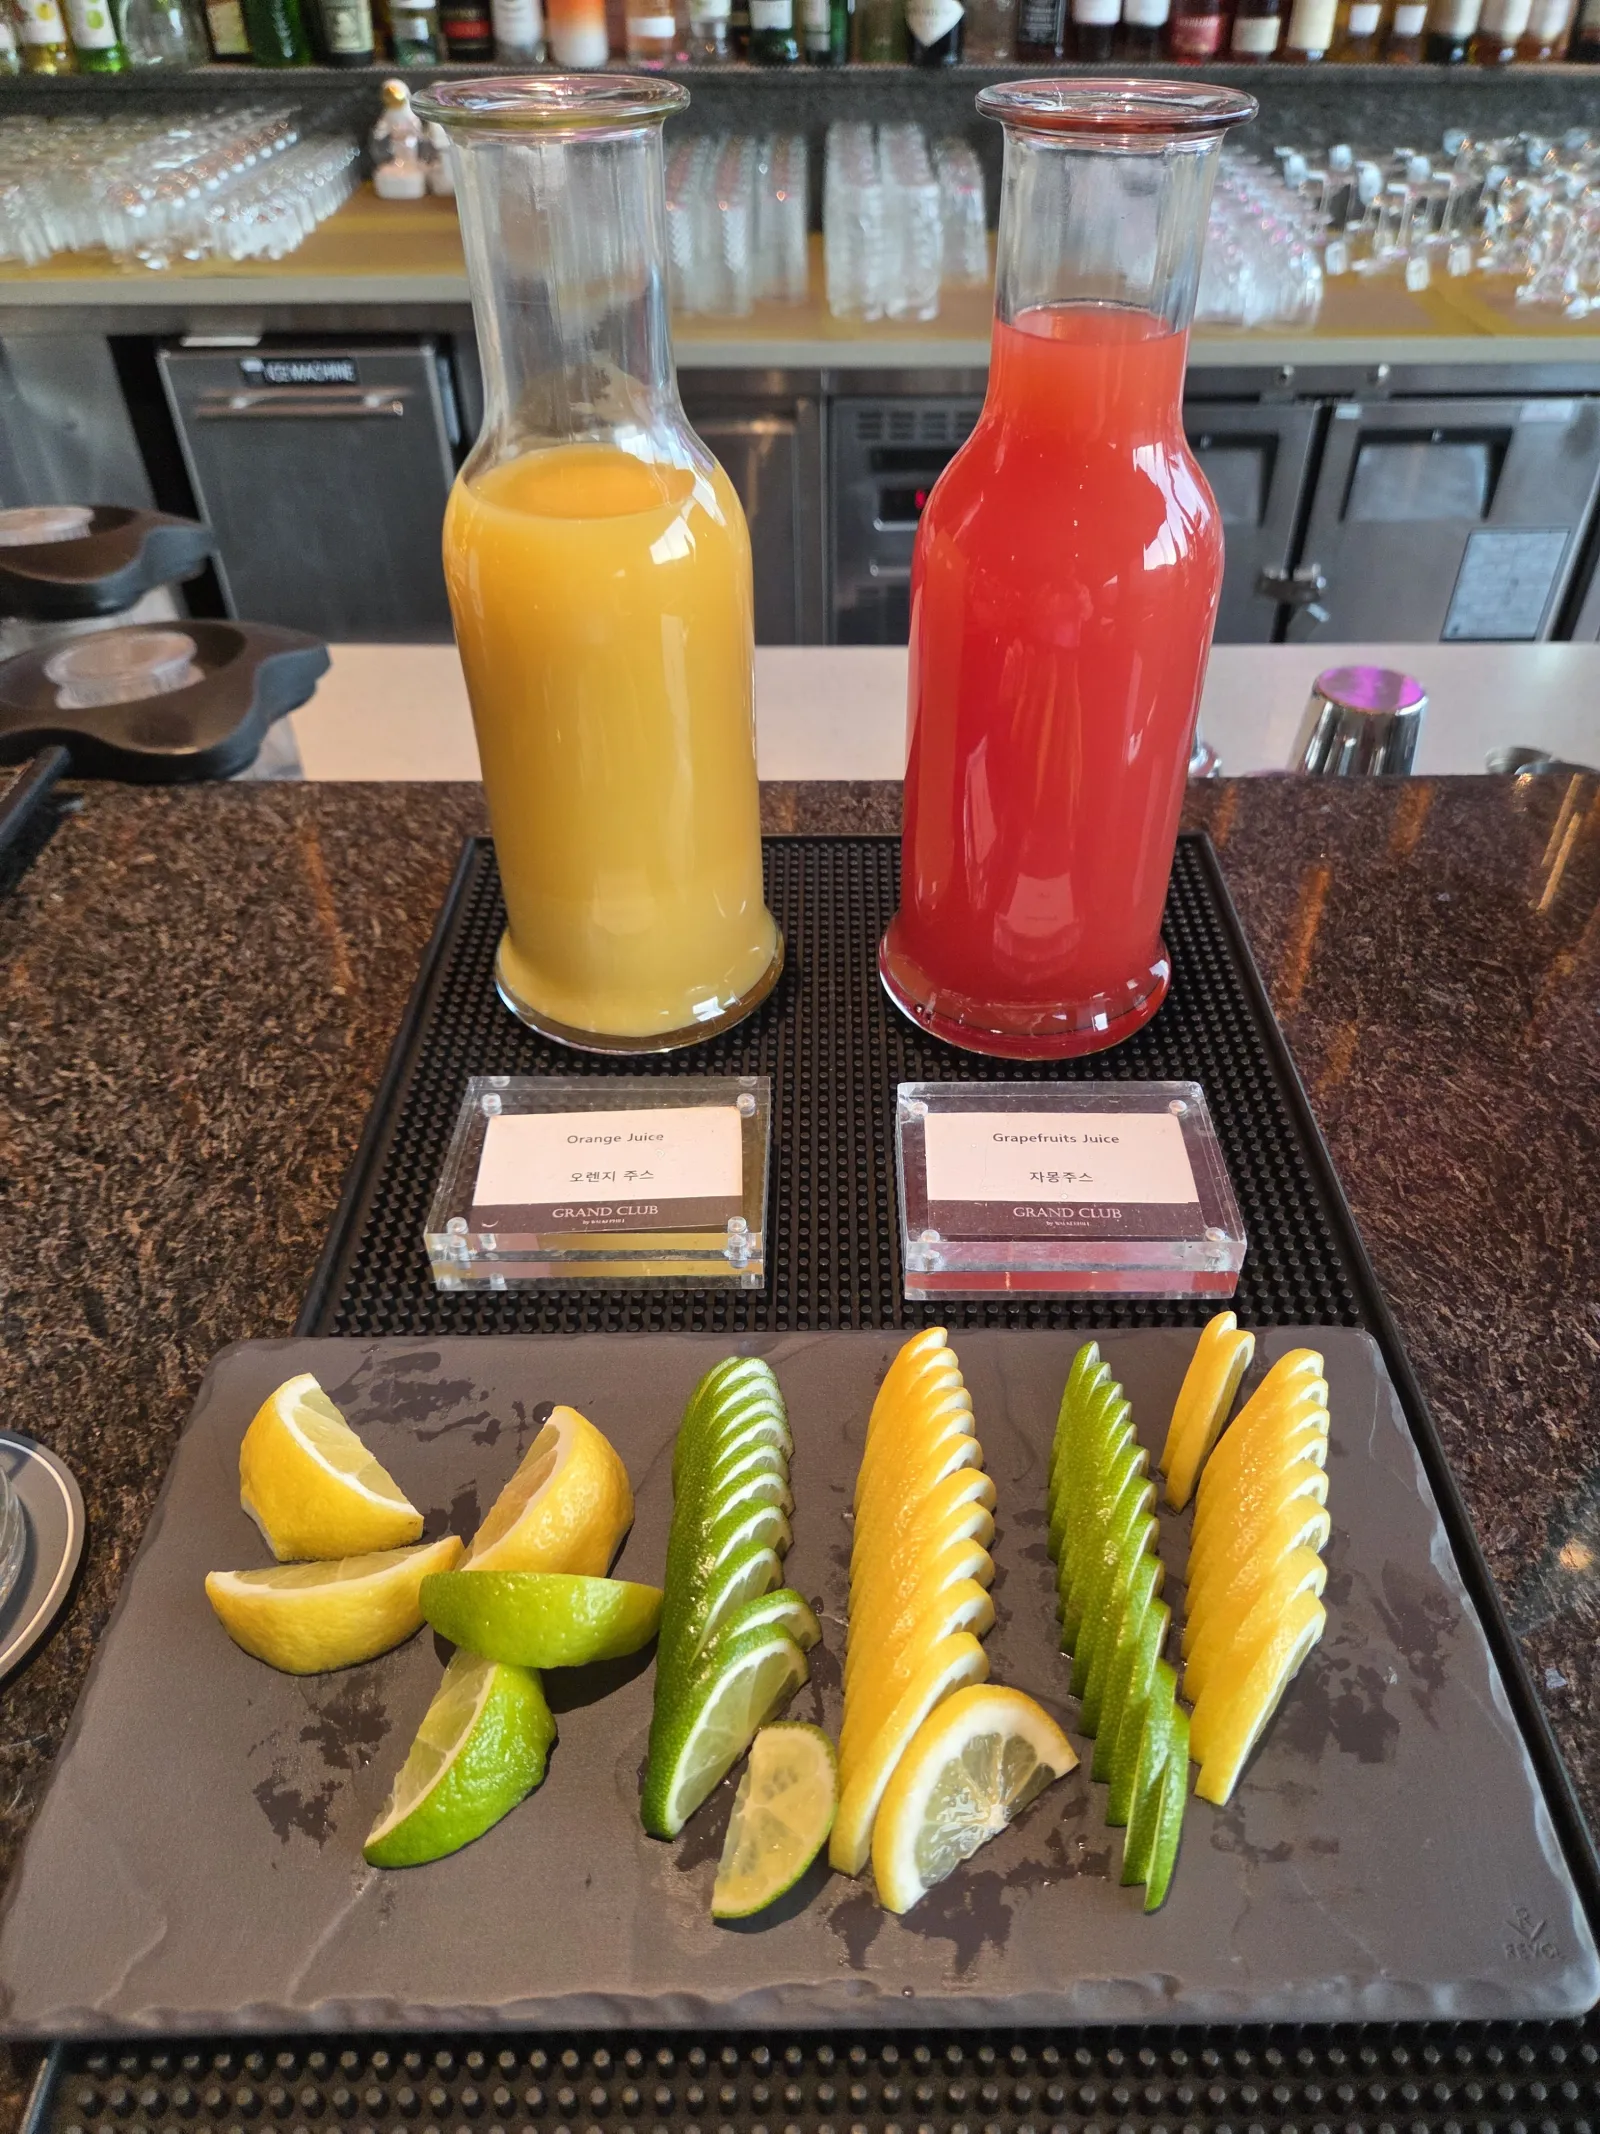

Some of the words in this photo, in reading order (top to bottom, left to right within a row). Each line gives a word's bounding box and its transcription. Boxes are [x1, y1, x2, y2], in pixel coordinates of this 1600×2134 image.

[567, 1135, 622, 1145] Orange
[627, 1132, 664, 1142] Juice
[992, 1133, 1077, 1144] Grapefruits
[1082, 1134, 1120, 1143] Juice
[569, 1170, 616, 1182] 오렌지
[623, 1169, 655, 1181] 주스
[1029, 1171, 1094, 1183] 자몽주스
[552, 1206, 613, 1218] GRAND
[616, 1205, 659, 1216] CLUB
[1012, 1206, 1074, 1218] GRAND
[1078, 1207, 1122, 1219] CLUB
